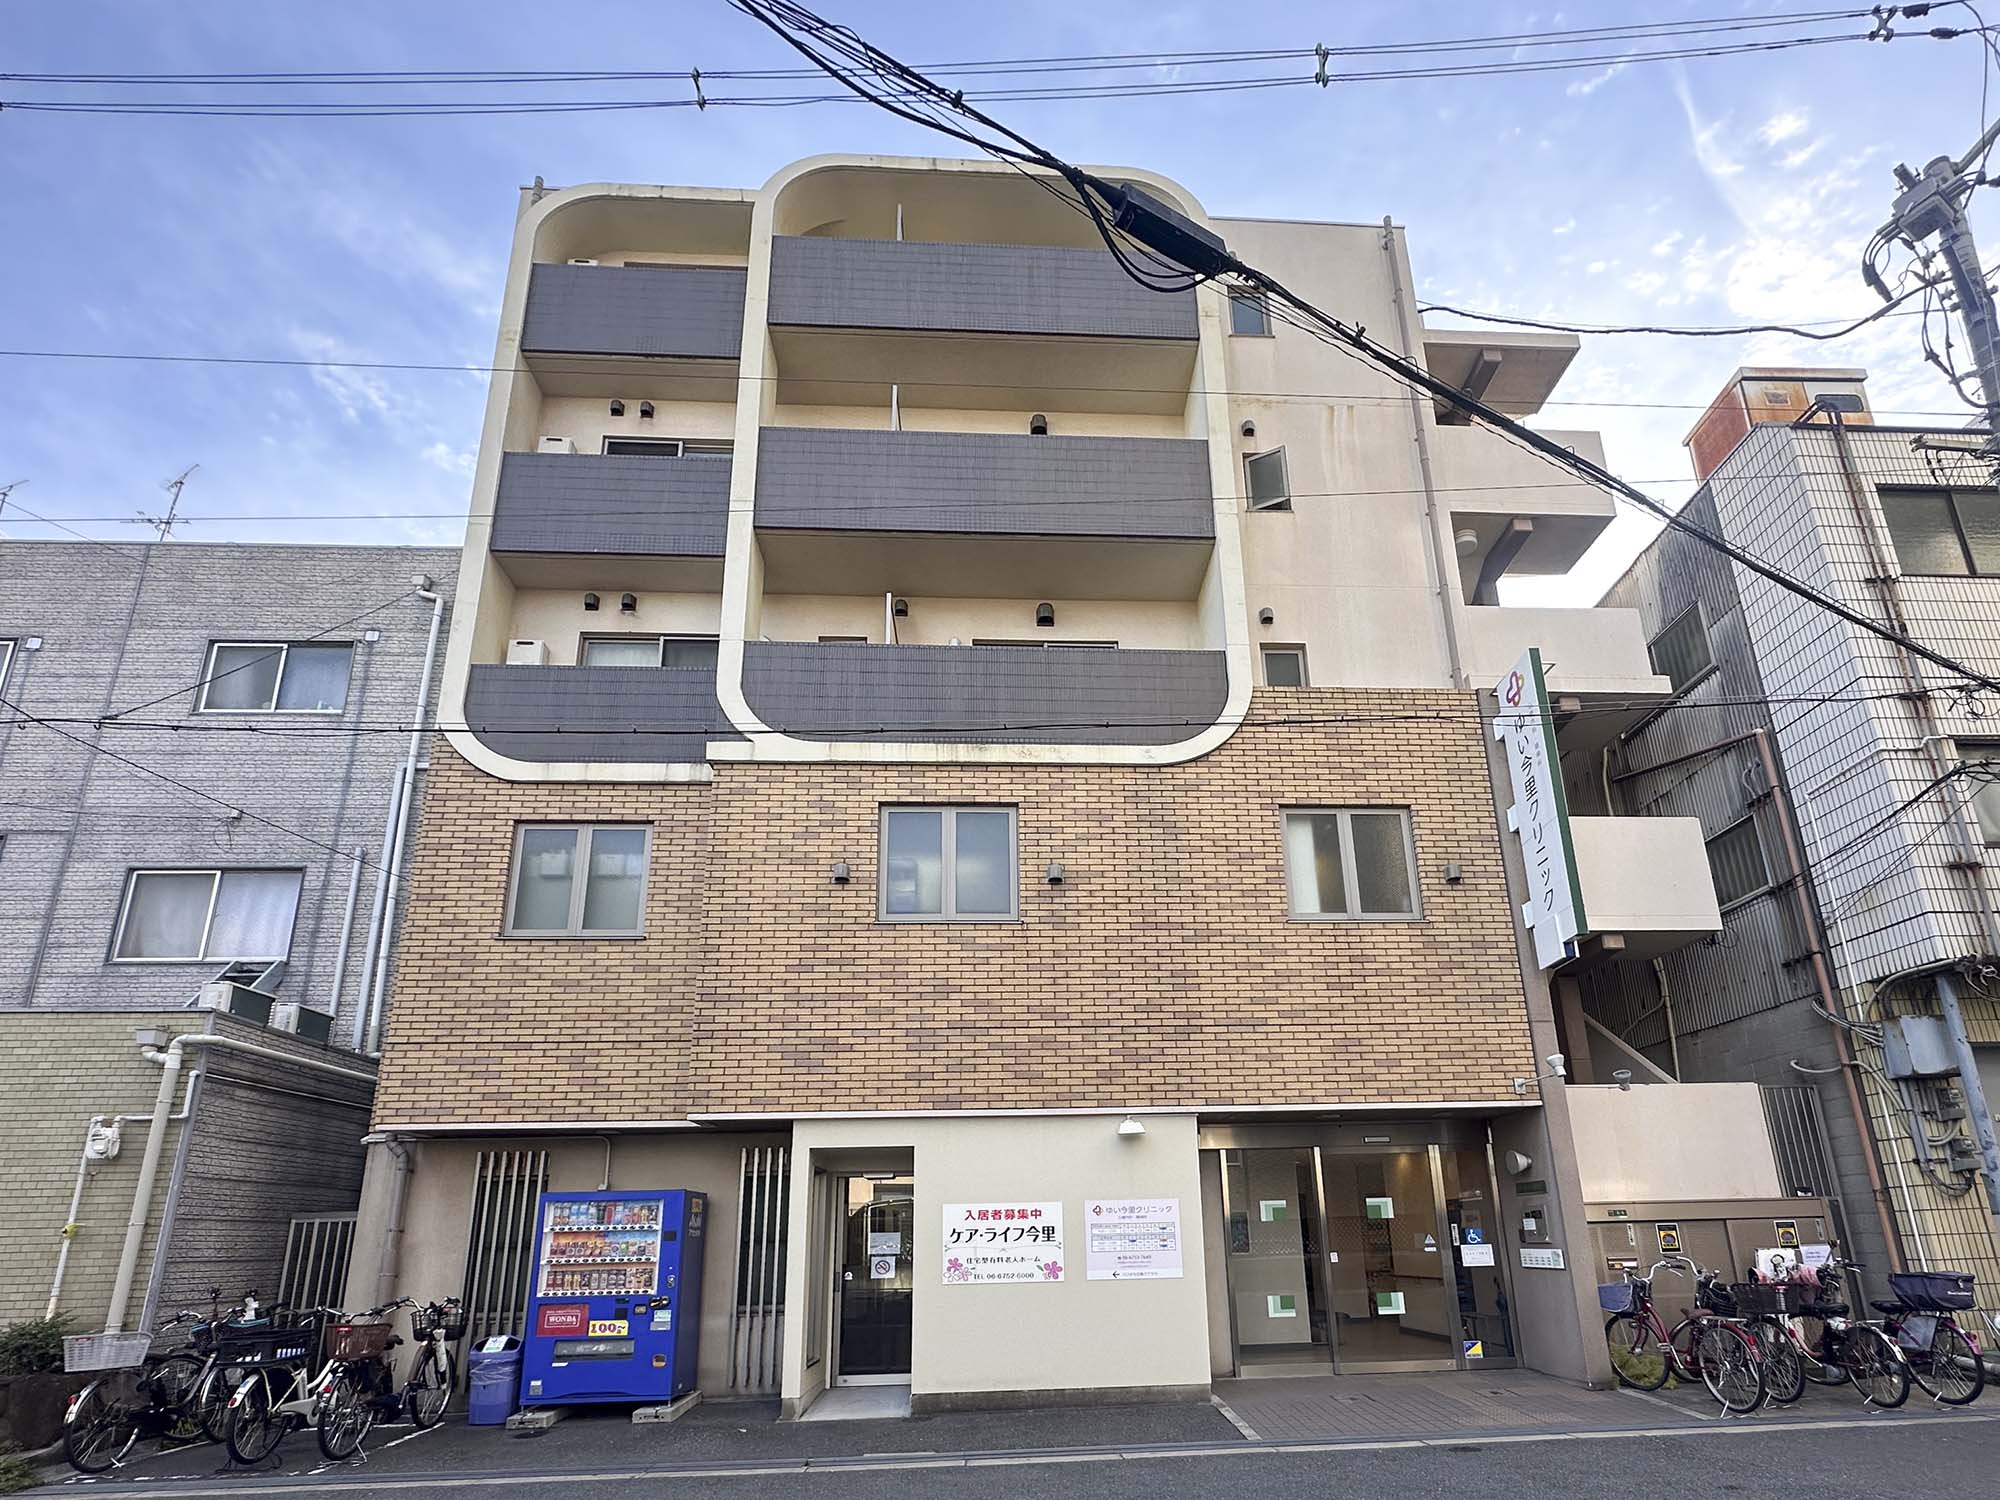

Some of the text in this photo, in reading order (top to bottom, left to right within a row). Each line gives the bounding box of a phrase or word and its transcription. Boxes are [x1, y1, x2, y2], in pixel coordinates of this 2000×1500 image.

[1513, 712, 1554, 912] ゆい今里クリニック
[964, 1208, 1042, 1221] 入居者募集中
[966, 1256, 1041, 1265] 住宅型有料老人ホーム
[548, 1315, 577, 1324] WONDA
